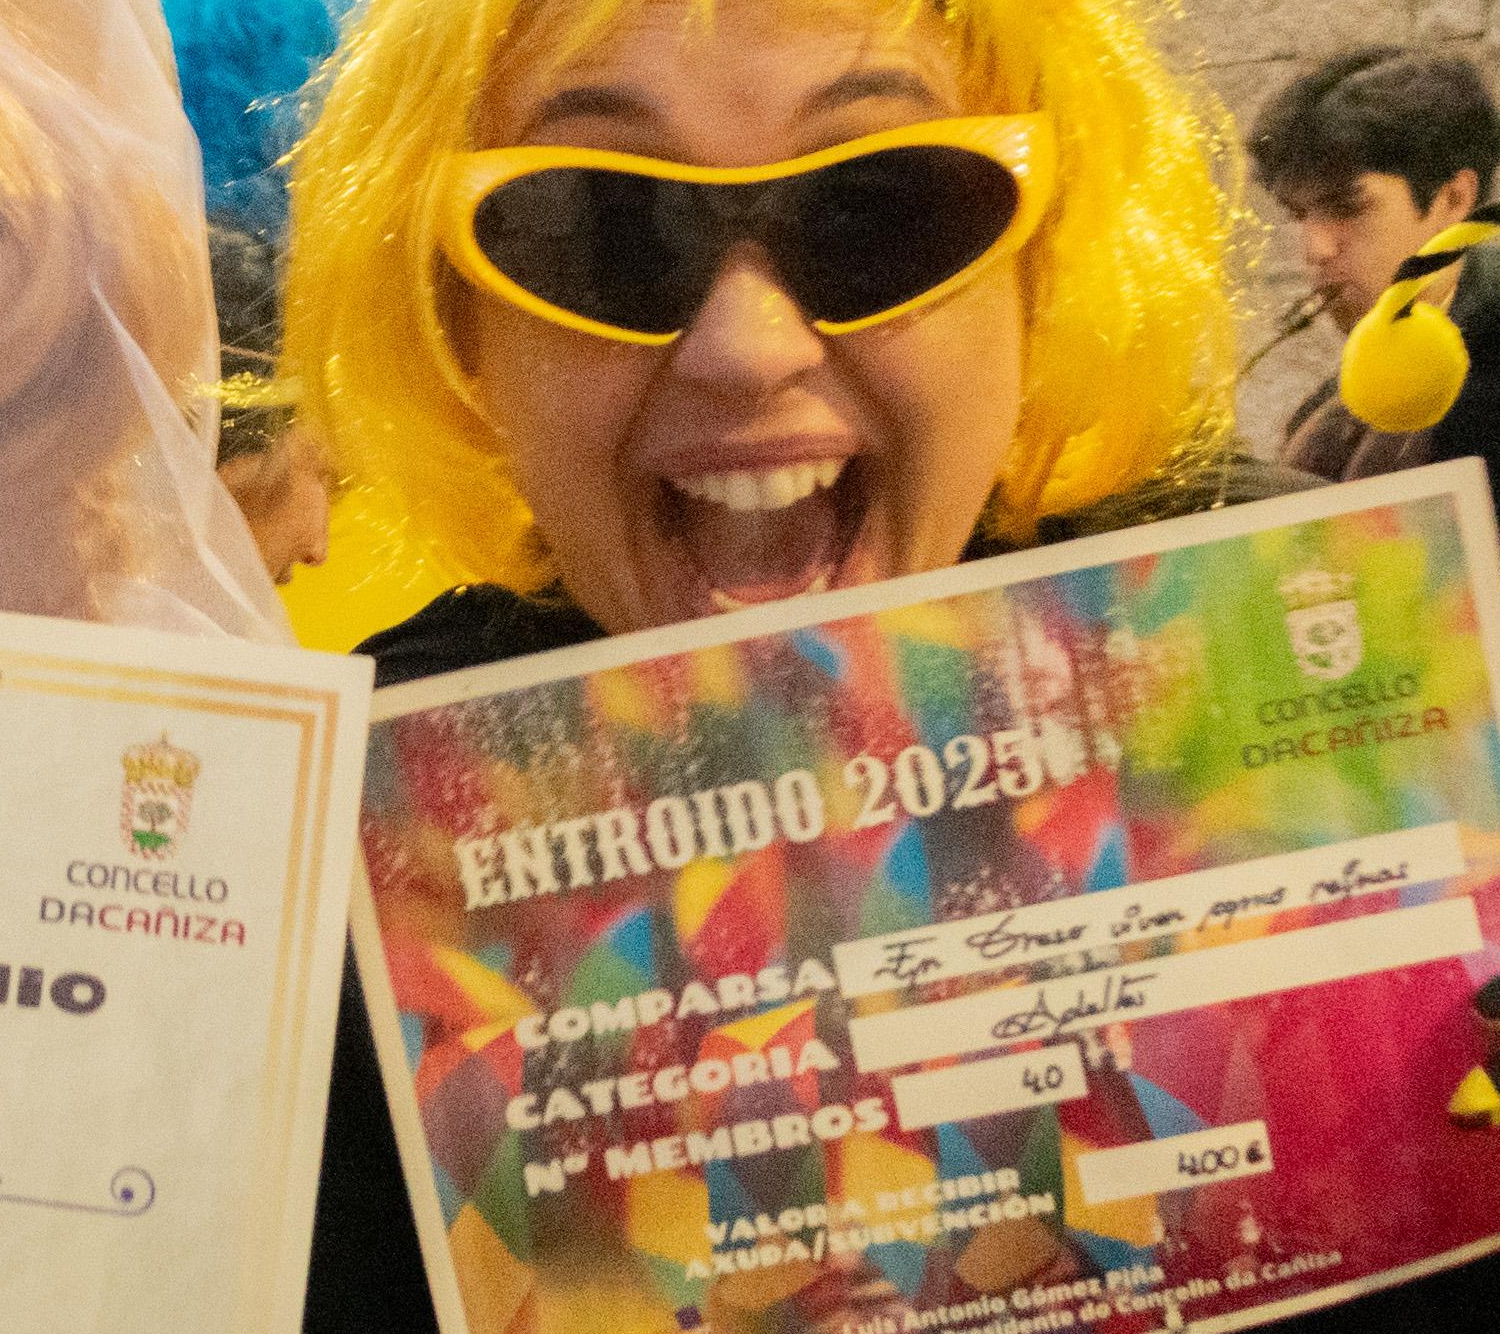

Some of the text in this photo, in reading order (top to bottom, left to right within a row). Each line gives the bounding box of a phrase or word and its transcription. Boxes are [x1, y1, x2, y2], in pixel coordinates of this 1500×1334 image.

[1257, 673, 1420, 726] CONCELLO
[455, 731, 1041, 911] ENTROIDO 2025
[66, 859, 229, 904] CONCELLO
[512, 959, 839, 1049] COMPARSA
[506, 1039, 840, 1132] CATEGORIA
[604, 1095, 891, 1181] MEMBROS
[705, 1167, 1020, 1245] VALOR A RECIBIR
[904, 1295, 1007, 1331] Antonio
[1012, 1277, 1101, 1310] Gómez
